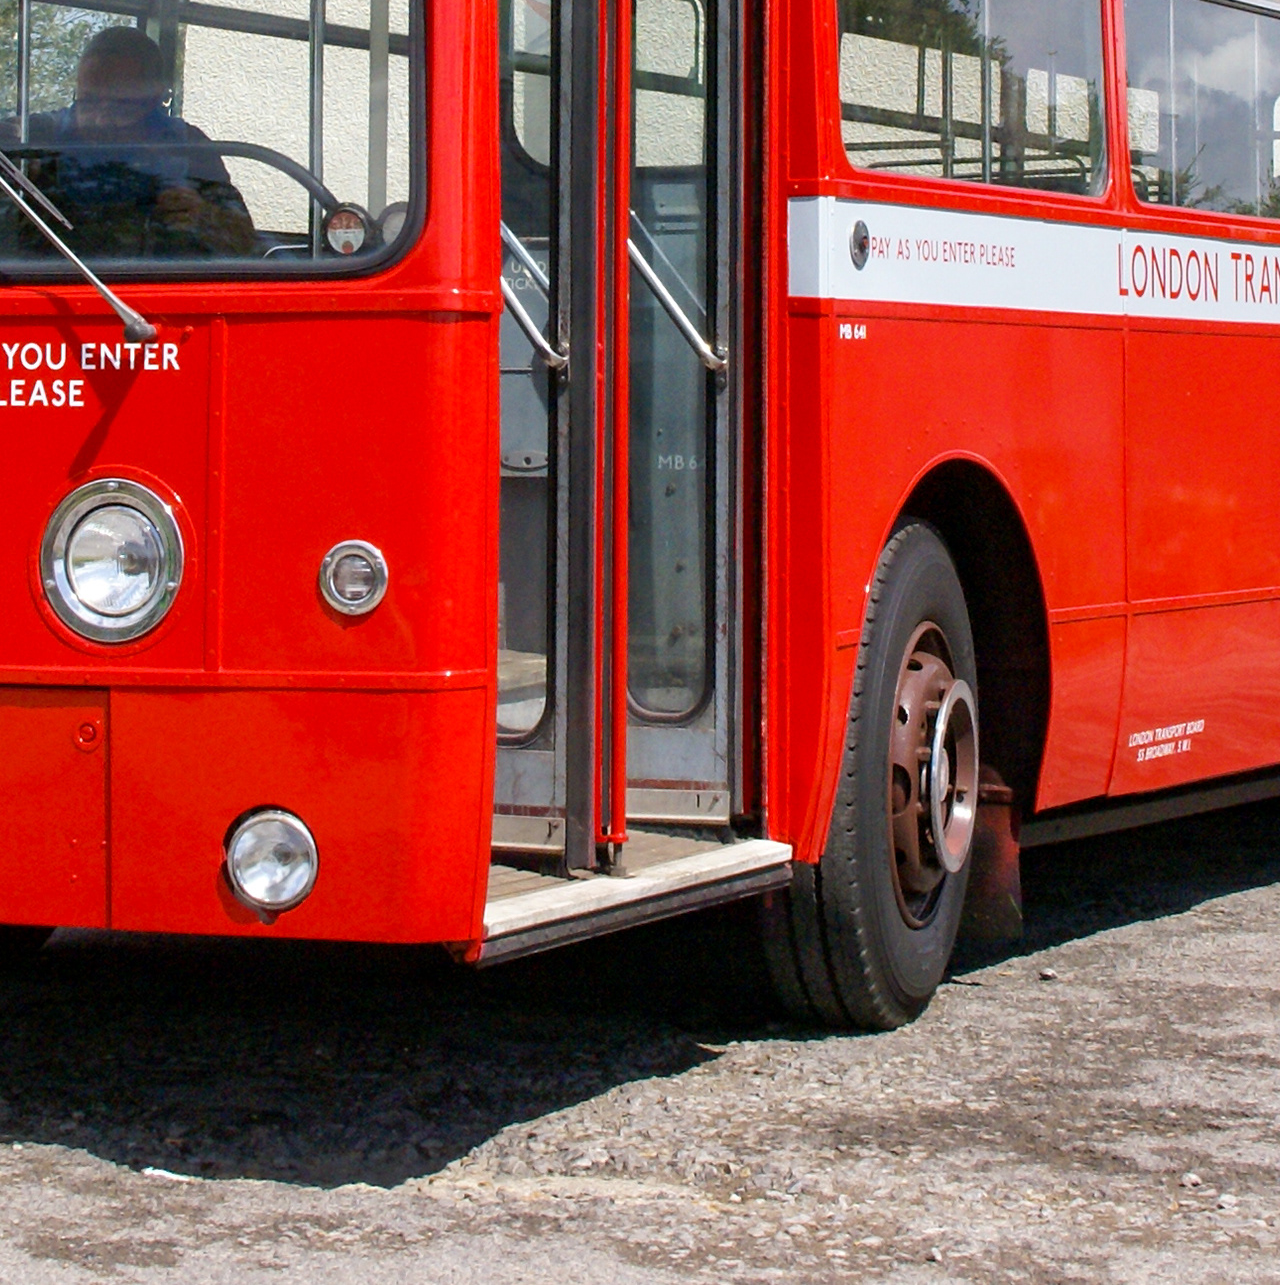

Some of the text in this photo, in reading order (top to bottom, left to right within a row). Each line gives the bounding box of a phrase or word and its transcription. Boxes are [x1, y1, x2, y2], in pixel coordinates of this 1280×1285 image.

[871, 236, 1016, 268] PAY AS YOU ENTER PLEASE
[511, 260, 547, 274] UD
[1118, 243, 1219, 303] LONDON
[839, 323, 867, 339] MB 641
[4, 342, 67, 372] YOU
[80, 342, 181, 372] ENTER
[658, 454, 684, 470] MB
[1128, 730, 1154, 747] LONDON
[1155, 723, 1186, 741] TRANSPORT
[1137, 748, 1145, 762] 55
